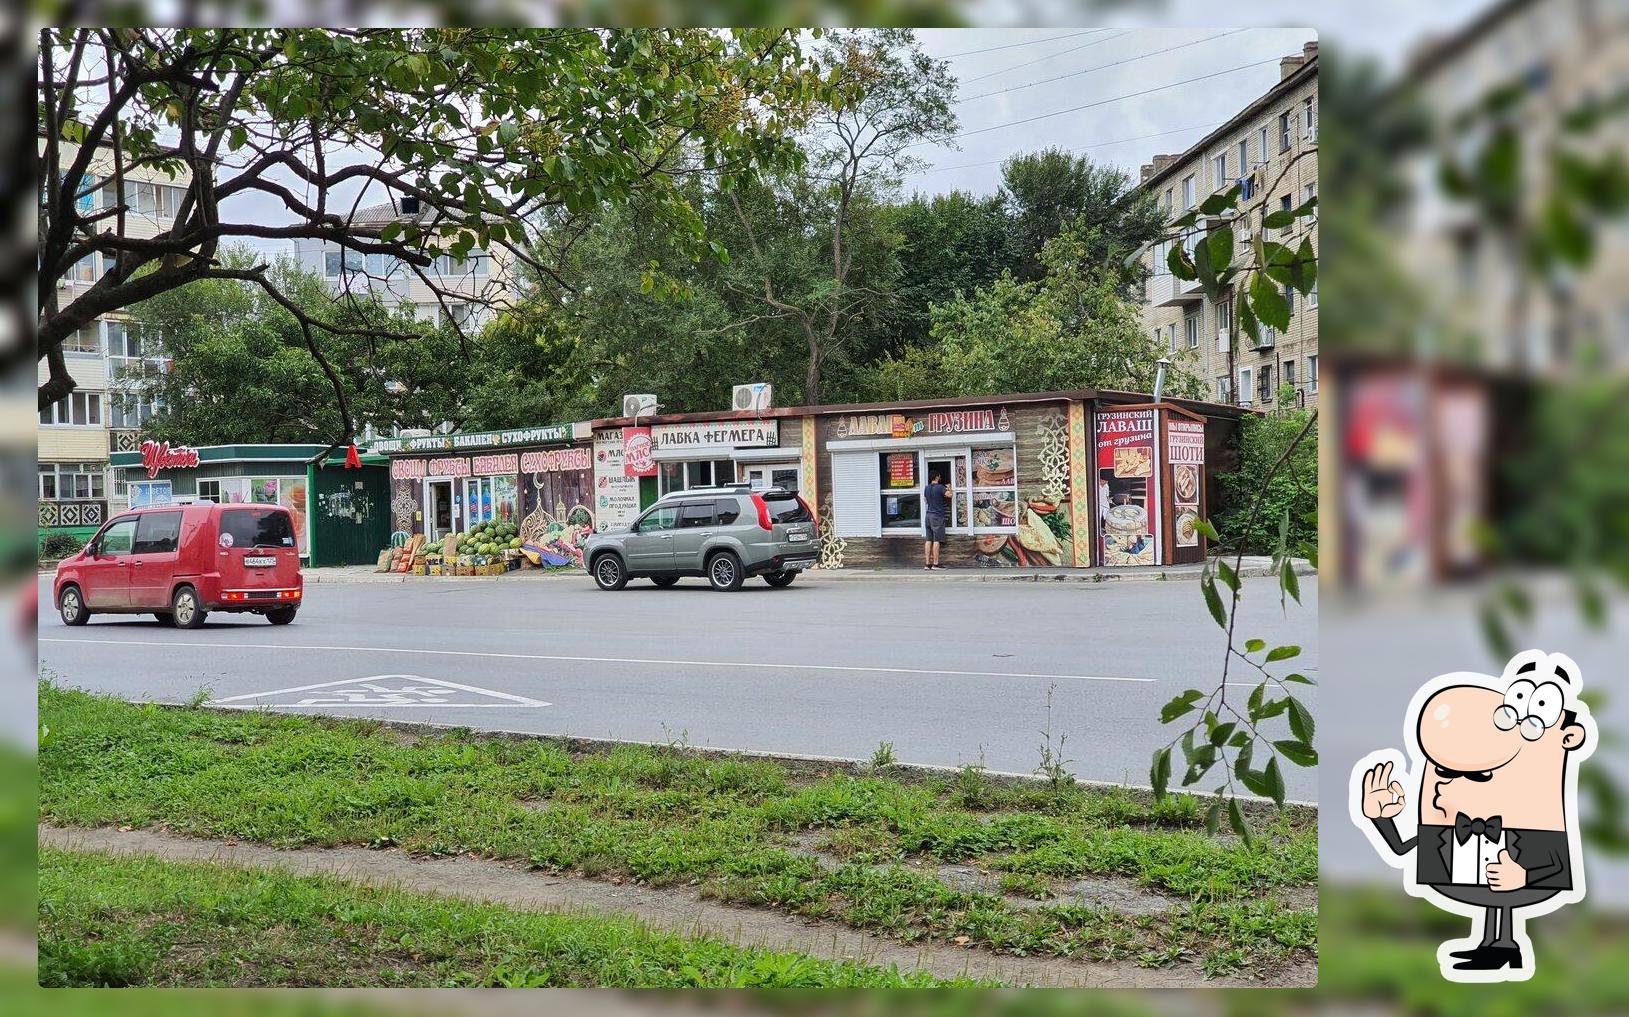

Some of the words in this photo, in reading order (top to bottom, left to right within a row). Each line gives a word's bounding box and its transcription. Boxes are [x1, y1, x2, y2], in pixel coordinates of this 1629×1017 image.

[928, 410, 995, 433] ГРУЗИНА
[1097, 410, 1153, 420] ГРУЗИНСКИЙ
[1097, 420, 1153, 433] ЛАВАШ
[410, 438, 444, 449] ФРУКТЫ
[454, 434, 492, 446] БАКАЛЕЯ
[502, 428, 561, 445] СУХОФРУКТЫ
[661, 431, 701, 445] ЛАВКА
[704, 429, 764, 443] ФЕРМЕРА
[1170, 446, 1204, 462] ШОТИ
